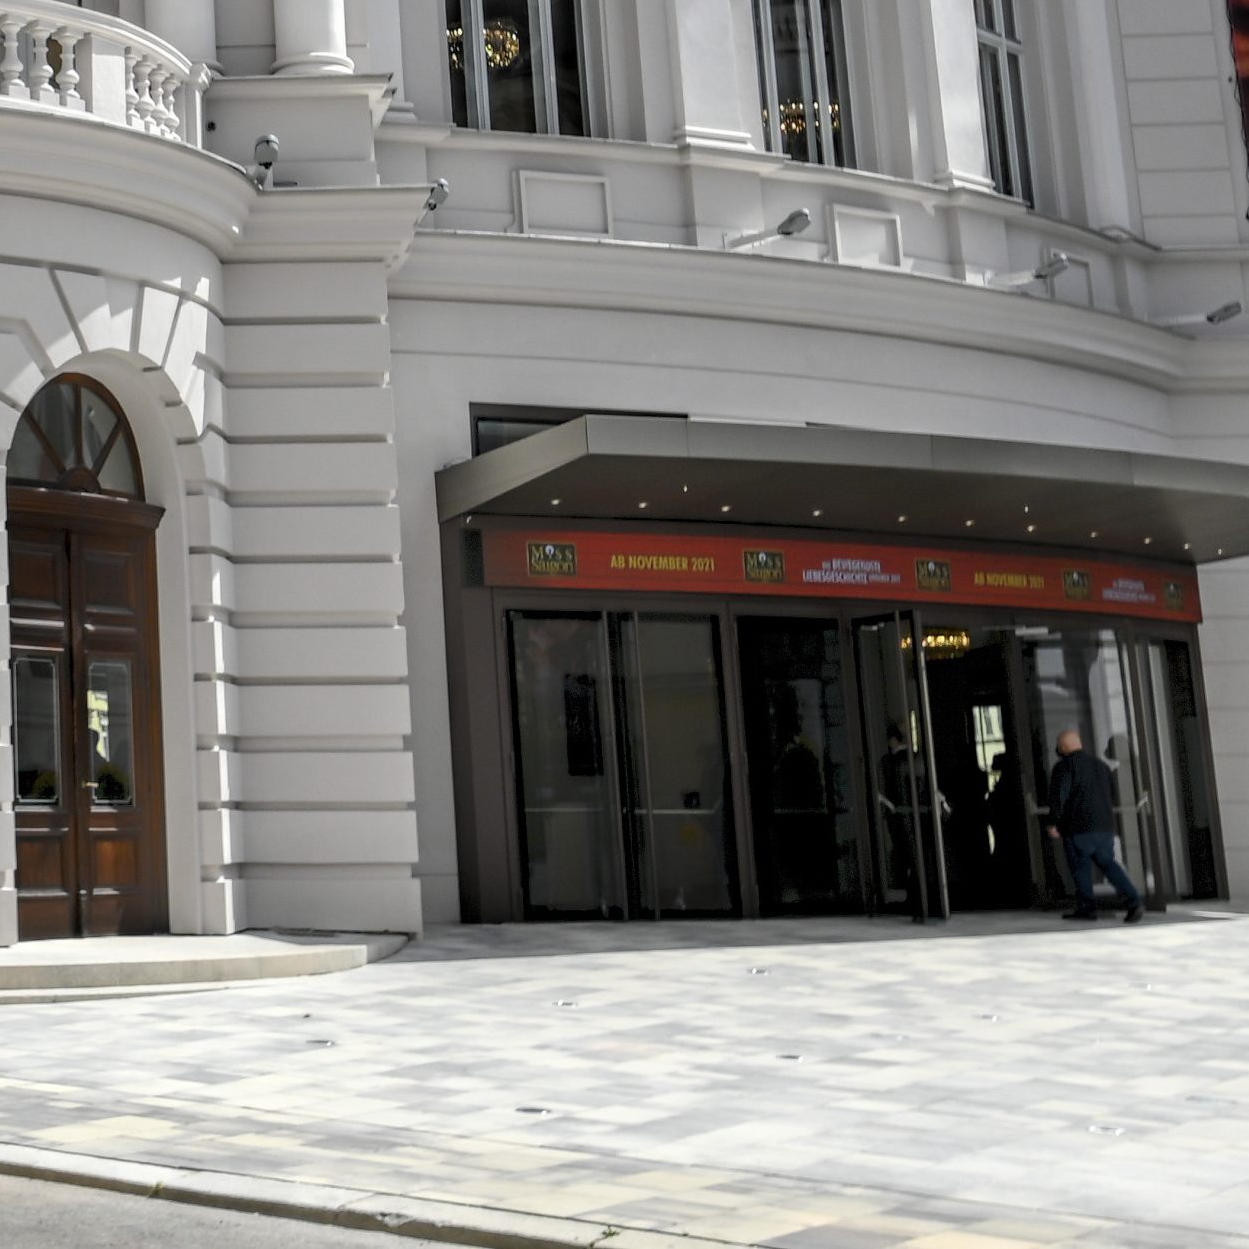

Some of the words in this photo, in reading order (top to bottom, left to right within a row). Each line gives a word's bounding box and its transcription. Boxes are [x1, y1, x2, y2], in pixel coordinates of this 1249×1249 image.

[611, 554, 625, 568] AB
[628, 555, 688, 570] NOVEMBER
[691, 557, 715, 571] 2021
